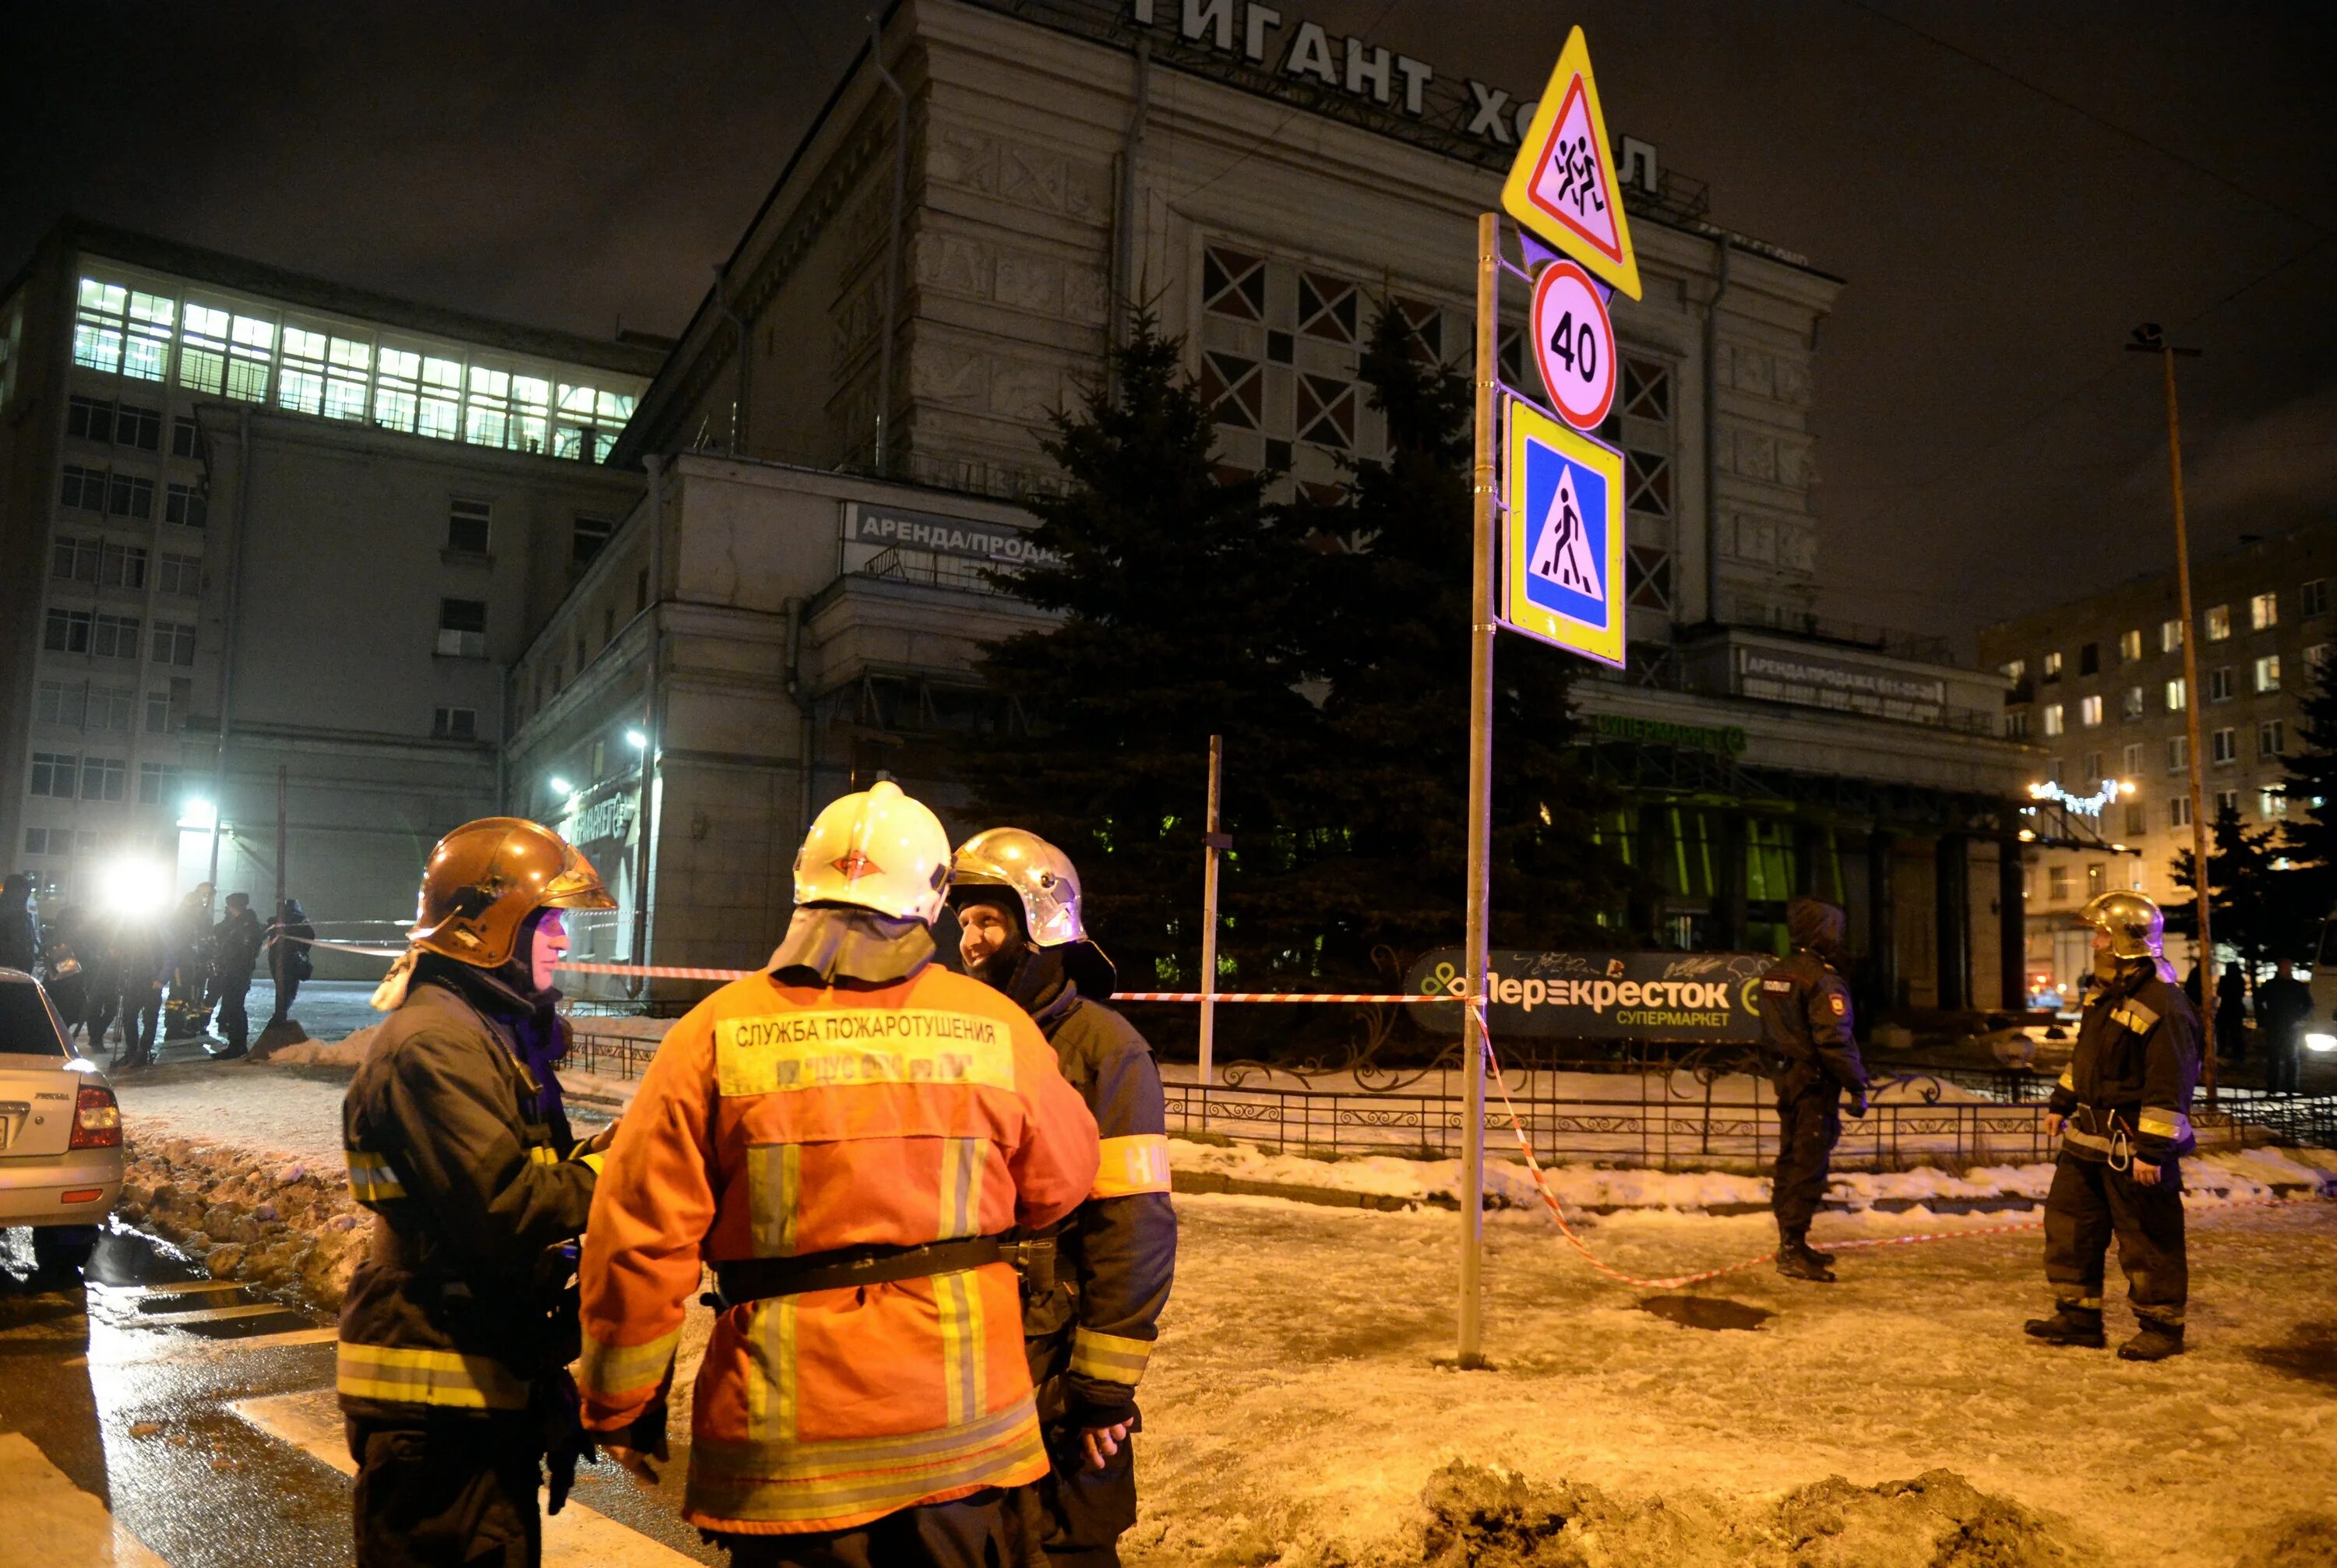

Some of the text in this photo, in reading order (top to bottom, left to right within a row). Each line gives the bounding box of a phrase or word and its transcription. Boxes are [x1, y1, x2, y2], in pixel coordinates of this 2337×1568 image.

[1467, 80, 1657, 193] ХЛ
[1551, 311, 1595, 382] 40
[736, 1016, 996, 1048] СЛУЖБА ПОЖАРОТУШЕНИЯ
[1616, 1010, 1730, 1027] СУПЕРМАРКЕТ
